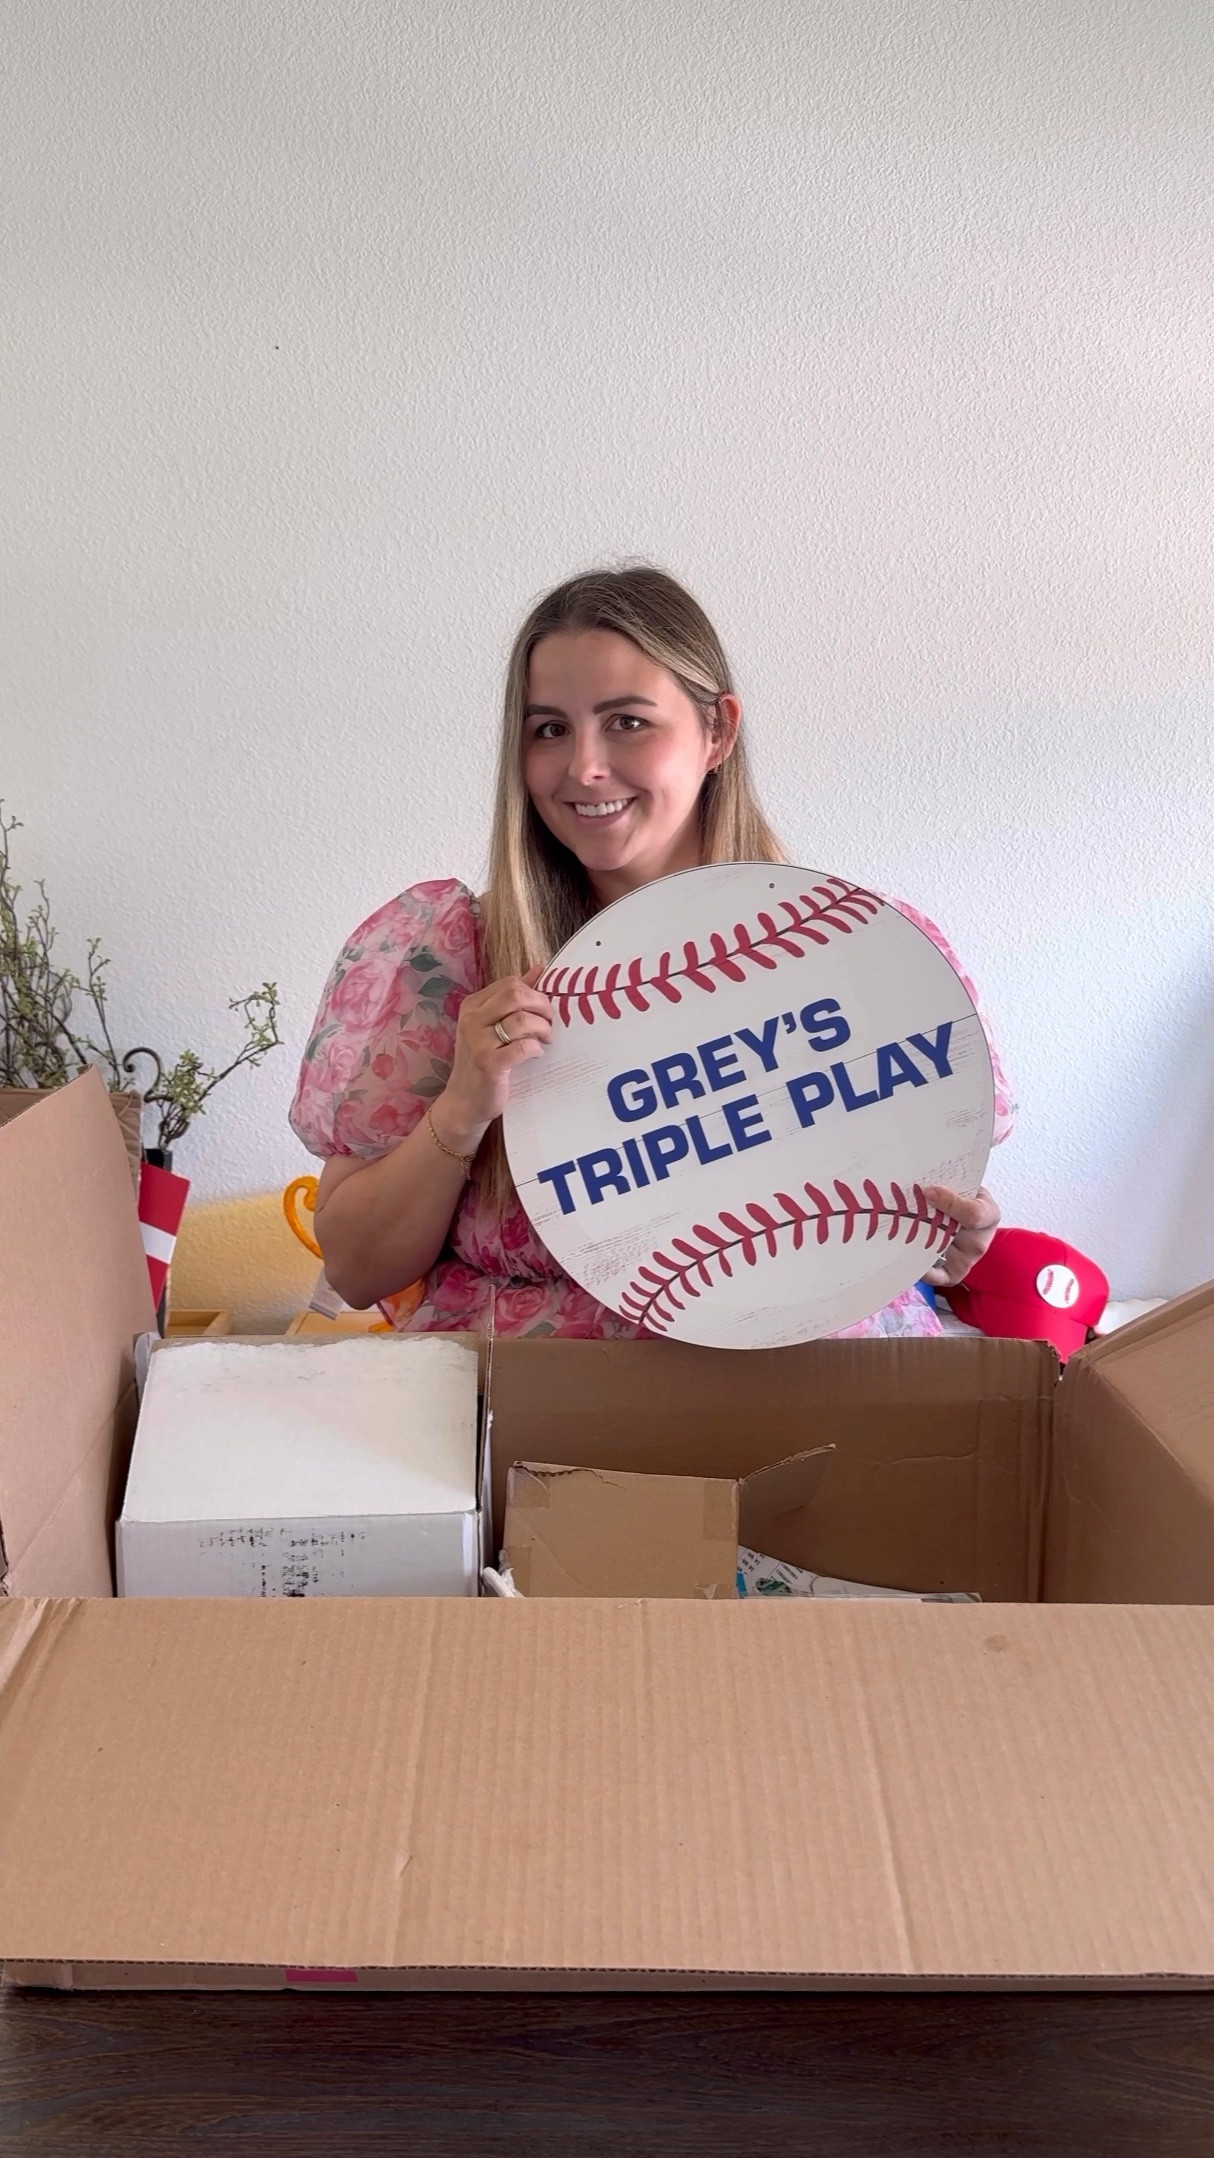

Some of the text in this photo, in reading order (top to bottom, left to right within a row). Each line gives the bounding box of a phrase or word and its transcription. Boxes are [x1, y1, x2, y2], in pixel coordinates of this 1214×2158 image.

[538, 1022, 952, 1214] TRIPLE PLAY
[607, 998, 851, 1122] GREY’S
